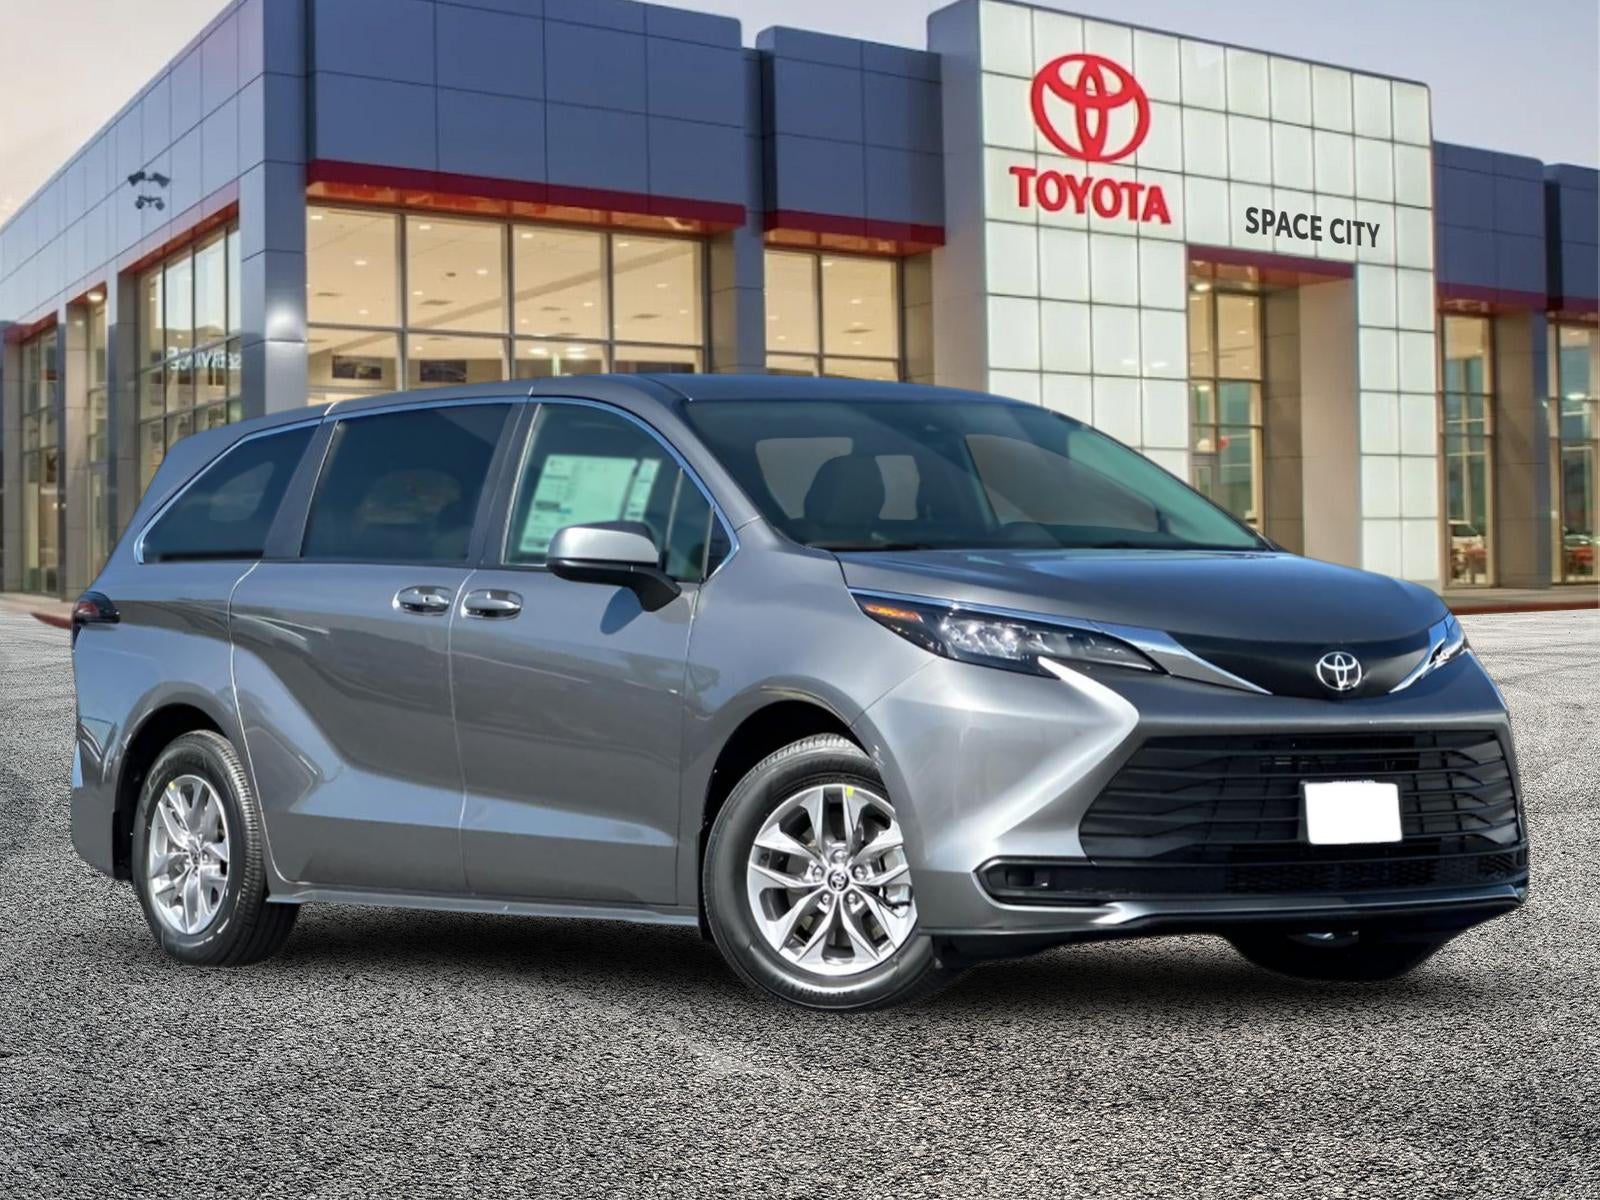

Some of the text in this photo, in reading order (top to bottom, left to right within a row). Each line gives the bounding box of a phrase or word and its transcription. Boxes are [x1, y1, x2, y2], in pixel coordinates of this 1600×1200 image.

[1009, 166, 1171, 224] TOYOTA
[1245, 207, 1381, 247] SPACE CITY
